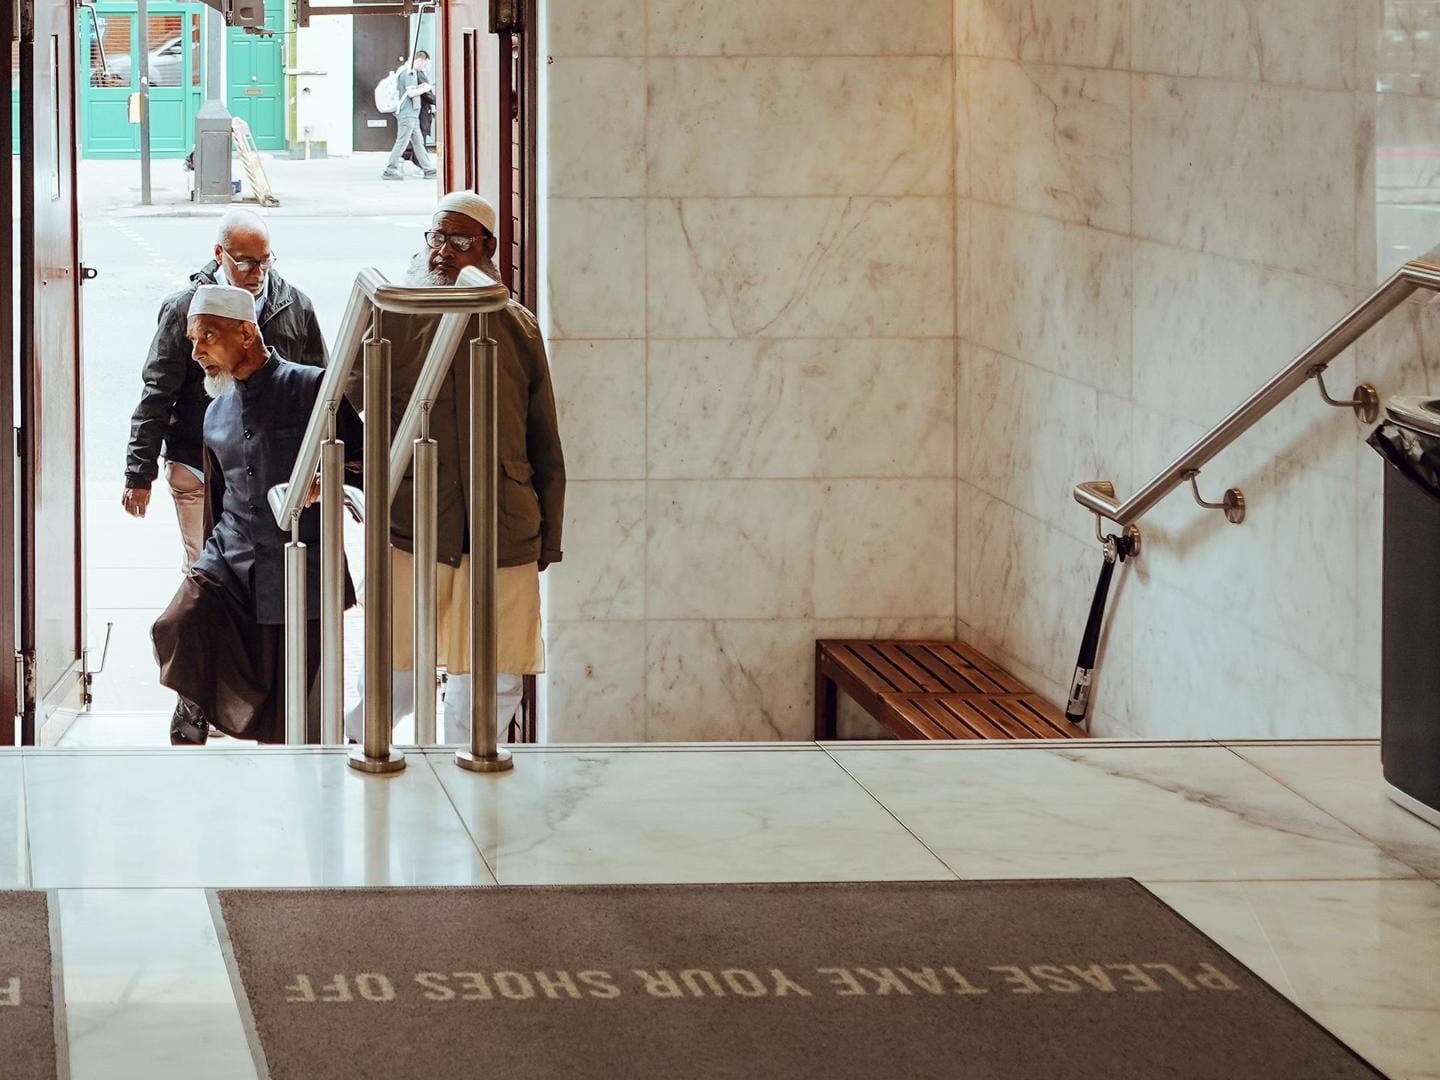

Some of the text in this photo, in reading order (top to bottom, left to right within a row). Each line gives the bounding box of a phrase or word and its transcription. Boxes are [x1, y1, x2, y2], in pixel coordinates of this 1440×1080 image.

[285, 962, 1241, 1003] PLEASE TAKE YOUR SHOES OFF
